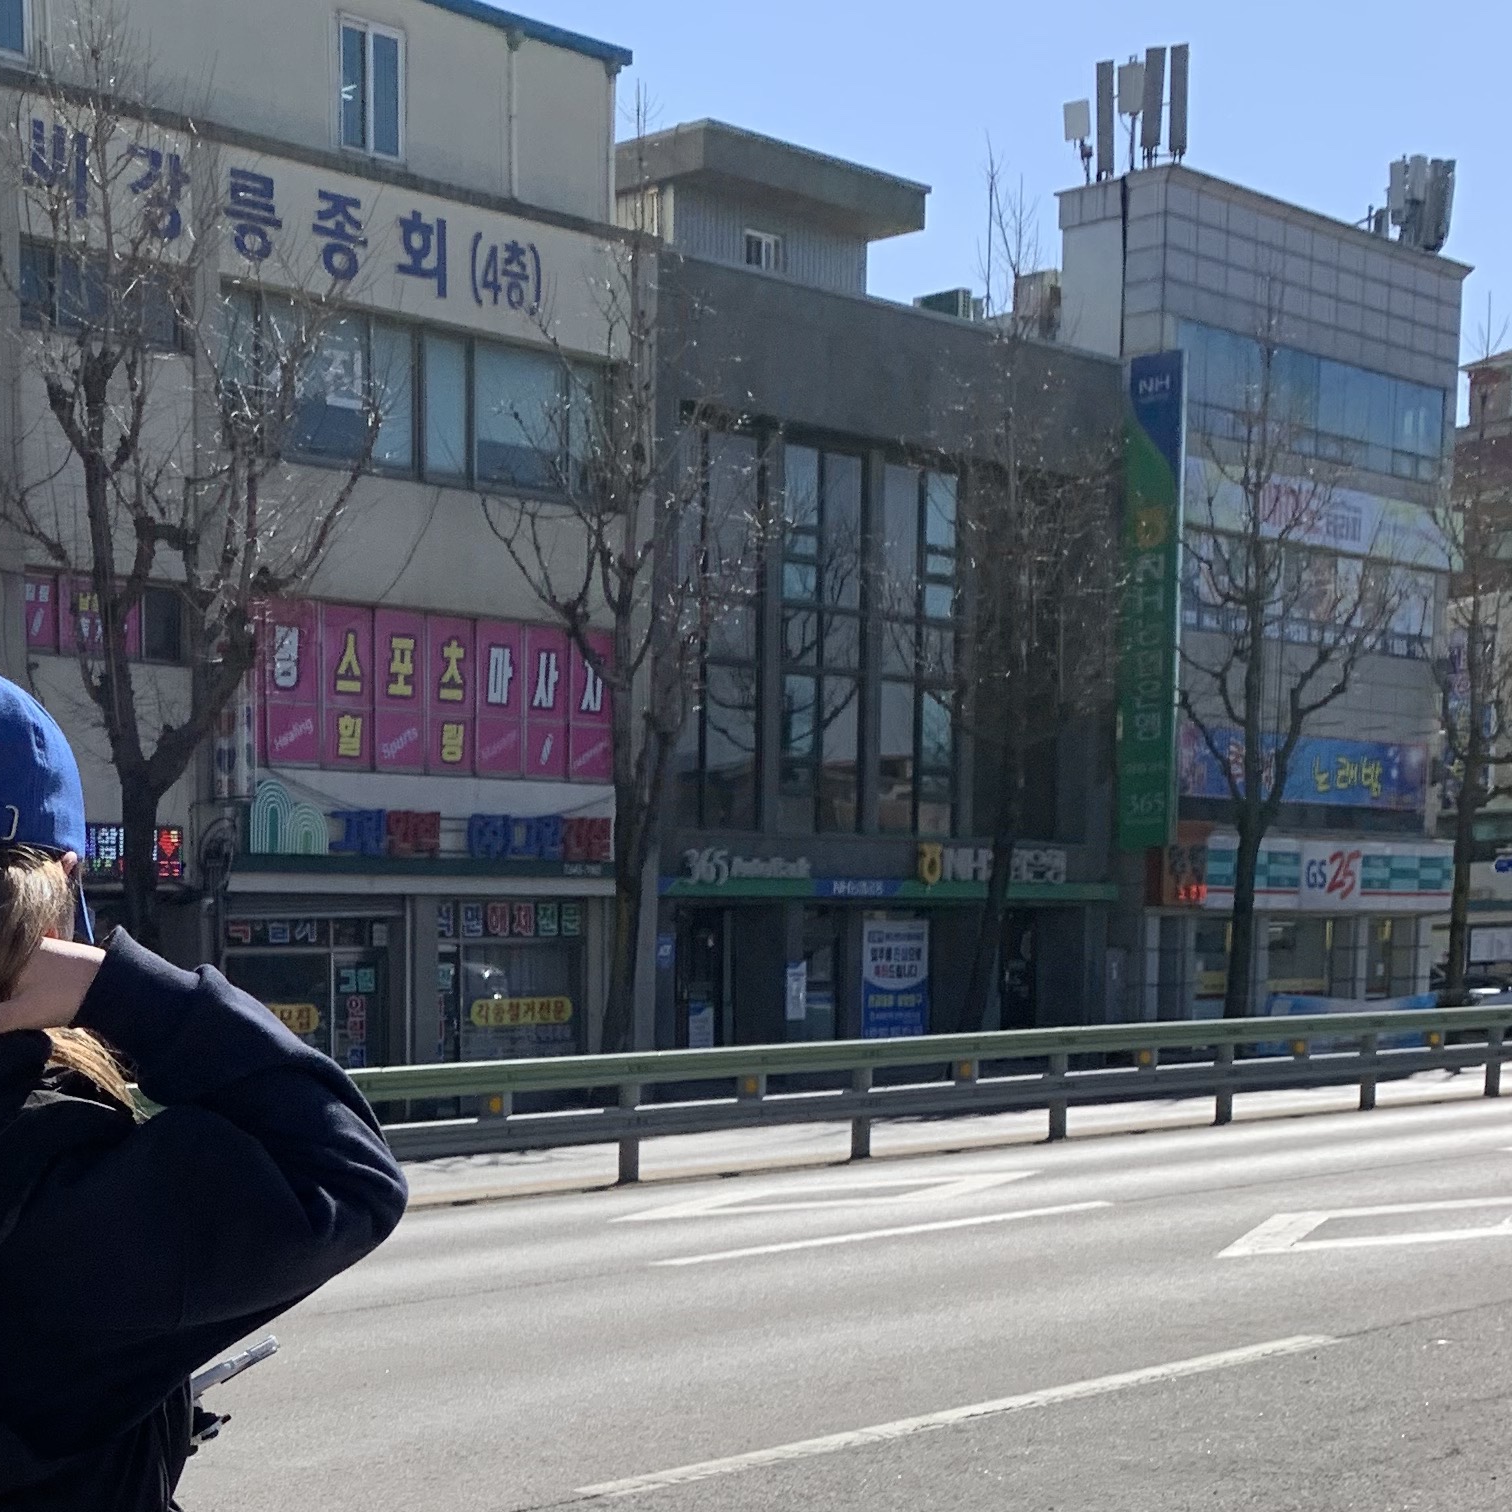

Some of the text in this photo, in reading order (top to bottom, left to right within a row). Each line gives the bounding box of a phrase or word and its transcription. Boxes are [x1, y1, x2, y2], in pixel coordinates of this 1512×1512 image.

[1139, 376, 1170, 393] NH
[336, 631, 466, 702] 스포츠
[1313, 754, 1384, 798] 노래방
[684, 848, 729, 887] 365
[1304, 849, 1362, 901] GS25
